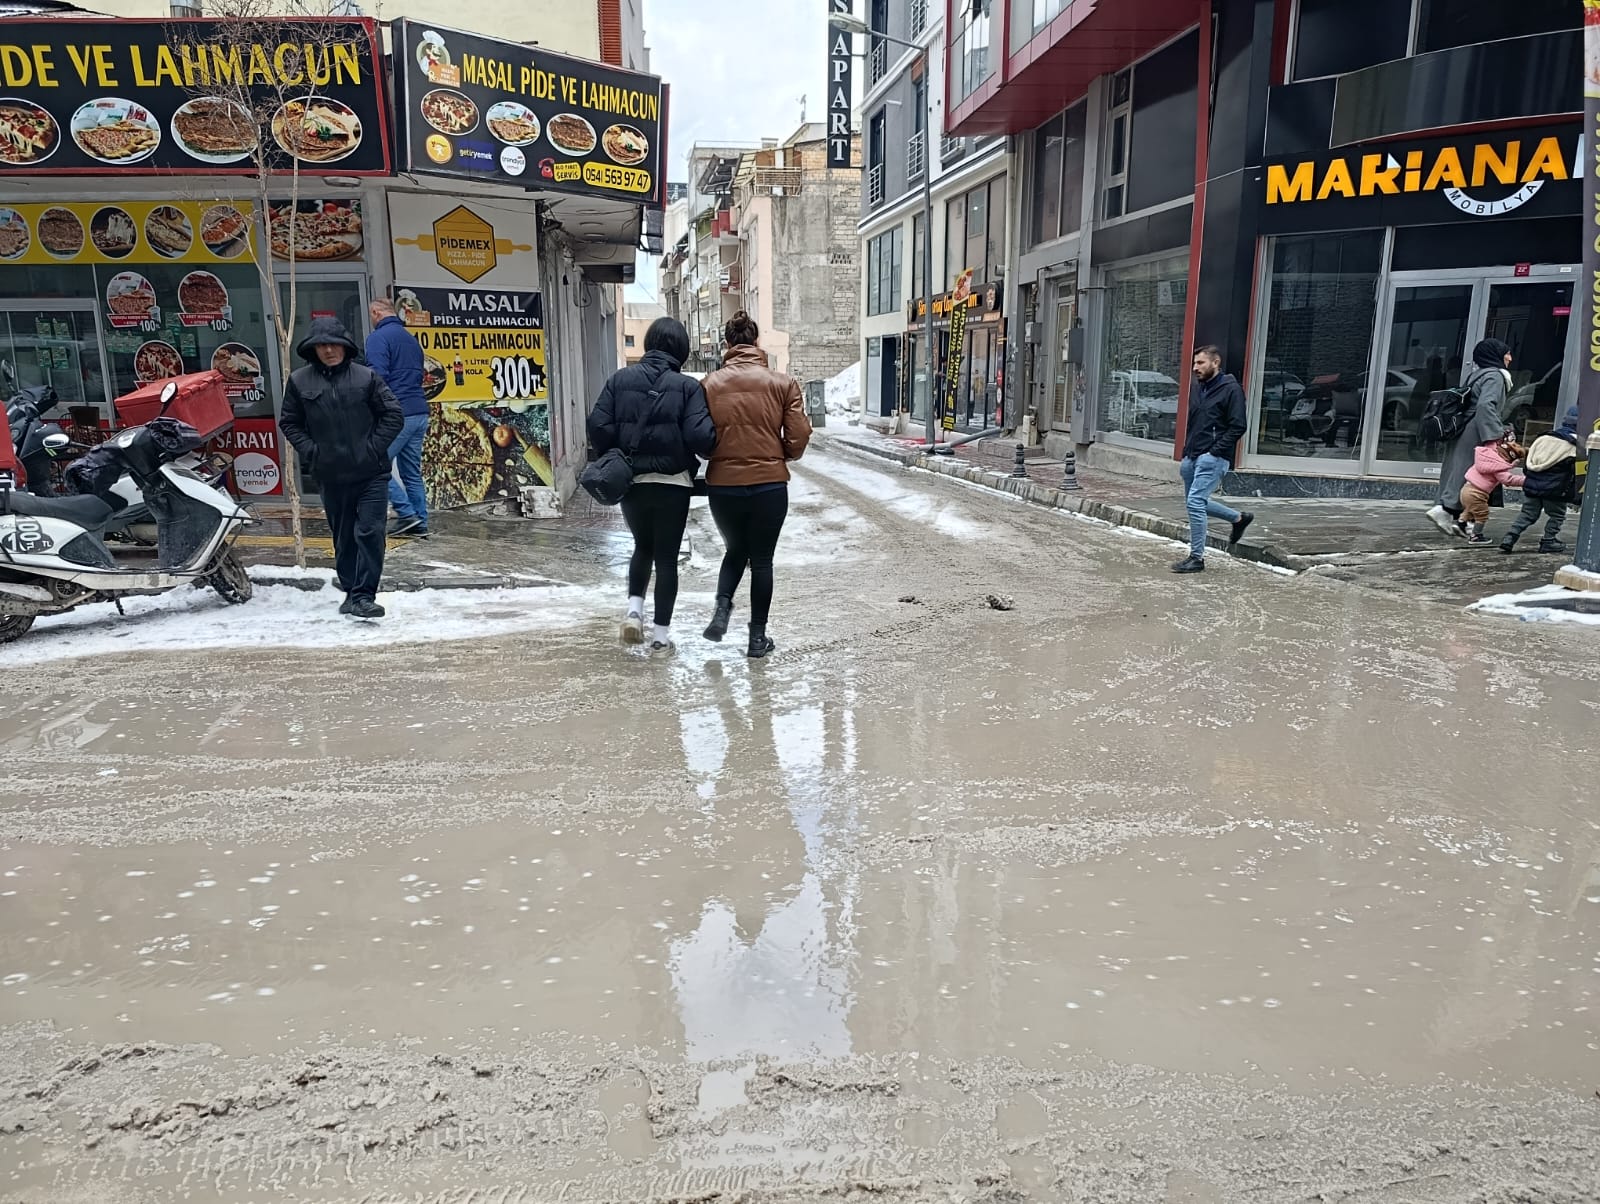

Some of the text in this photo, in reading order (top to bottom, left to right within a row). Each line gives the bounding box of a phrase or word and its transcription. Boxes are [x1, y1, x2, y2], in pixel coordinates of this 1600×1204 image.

[0, 43, 361, 87] DE VE LAHMACUN
[463, 53, 515, 93] MASAL
[521, 60, 556, 101] PİDE
[560, 75, 577, 105] VE
[582, 80, 658, 121] LAHMACUN
[831, 33, 850, 161] APART
[585, 168, 648, 189] 0541 563 97 47
[448, 293, 525, 312] MASAL
[140, 320, 156, 332] 100
[211, 320, 228, 331] 100
[433, 313, 461, 325] PİDE
[479, 317, 540, 327] LAHMACUN
[415, 332, 541, 350] 10 ADET LAHMACUN
[491, 357, 530, 399] 300
[244, 389, 260, 401] 100
